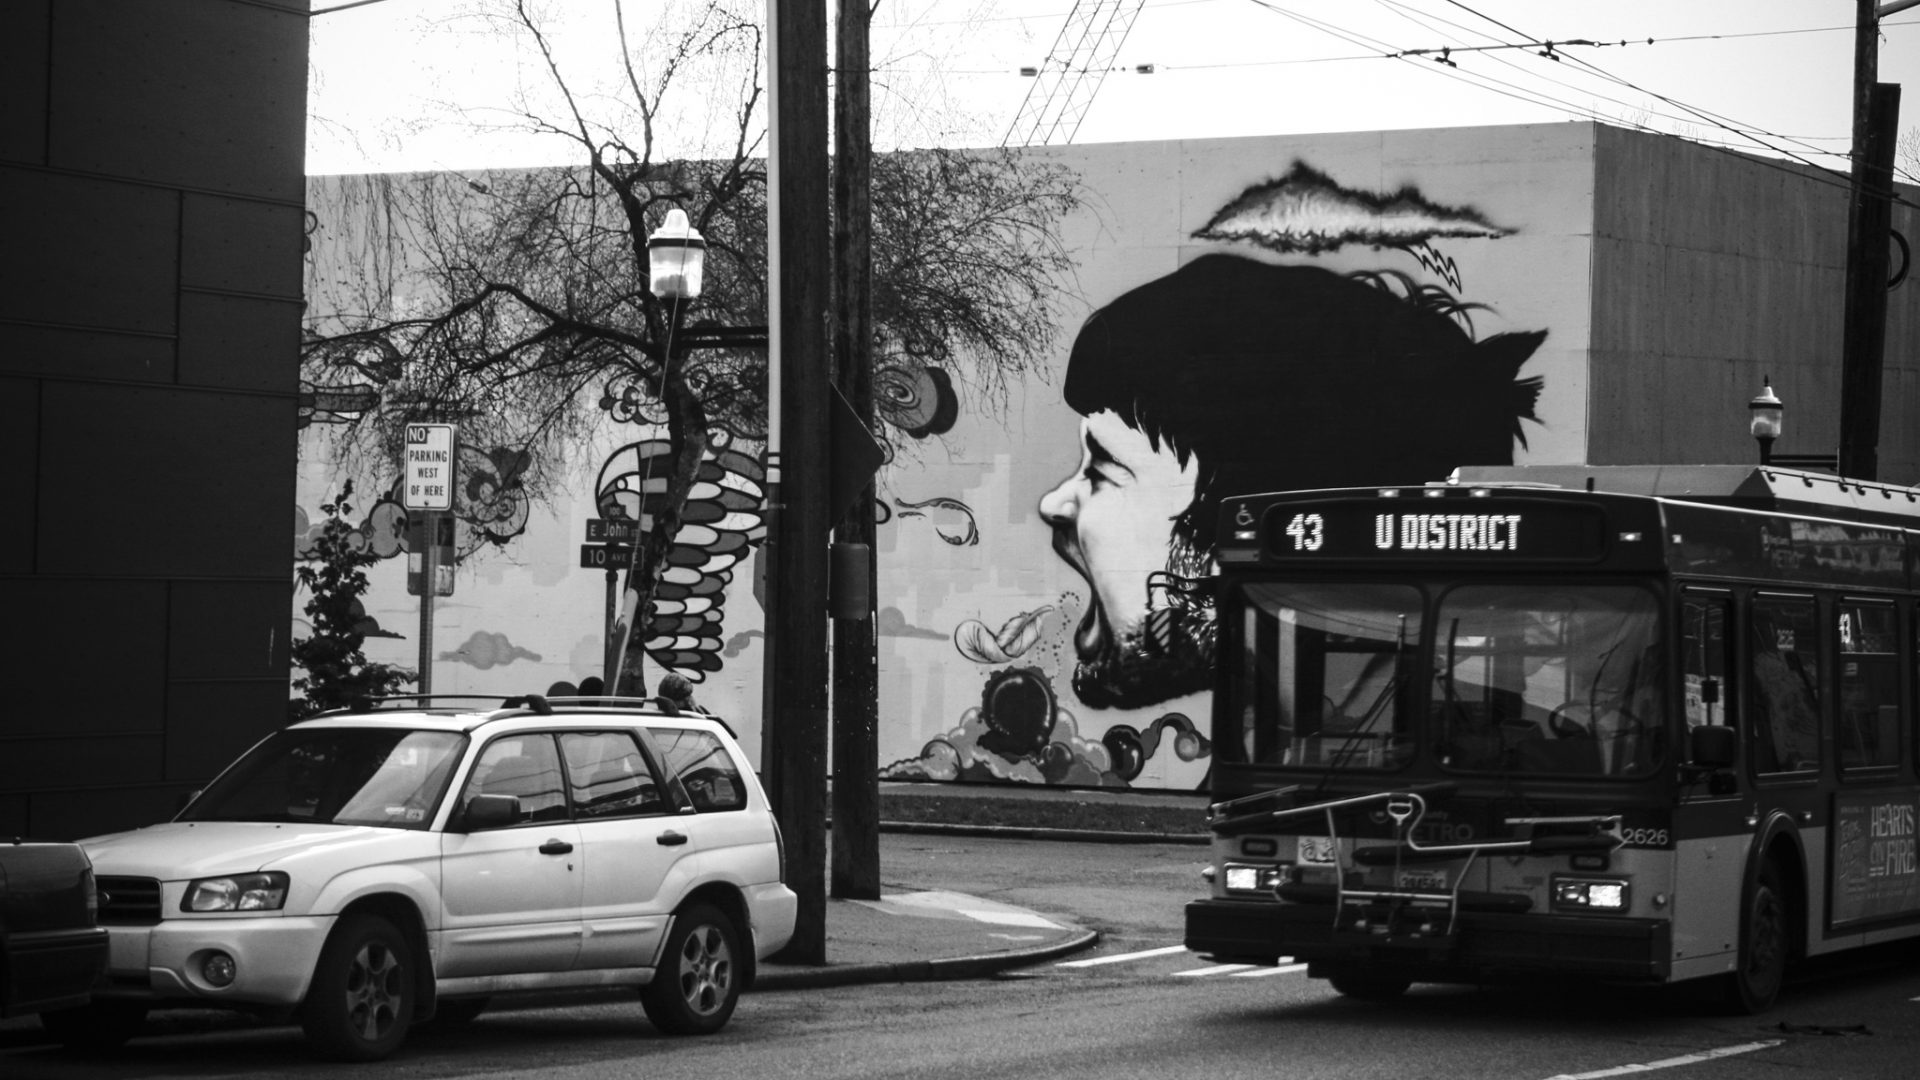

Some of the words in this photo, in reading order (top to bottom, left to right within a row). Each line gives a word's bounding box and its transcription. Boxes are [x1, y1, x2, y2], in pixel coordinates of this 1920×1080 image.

[409, 427, 426, 442] NO
[409, 450, 448, 463] PARKING
[418, 467, 438, 478] WEST
[411, 485, 421, 496] OF
[424, 485, 444, 497] HERE
[590, 524, 597, 537] E
[602, 521, 628, 537] John
[1286, 513, 1323, 551] 43
[1375, 514, 1394, 549] U
[1400, 514, 1522, 550] DISTRICT
[590, 549, 606, 565] 10
[611, 552, 627, 562] AVE
[1870, 803, 1914, 837] HEARTS
[1623, 827, 1669, 846] 2626
[1885, 838, 1915, 876] FIRE
